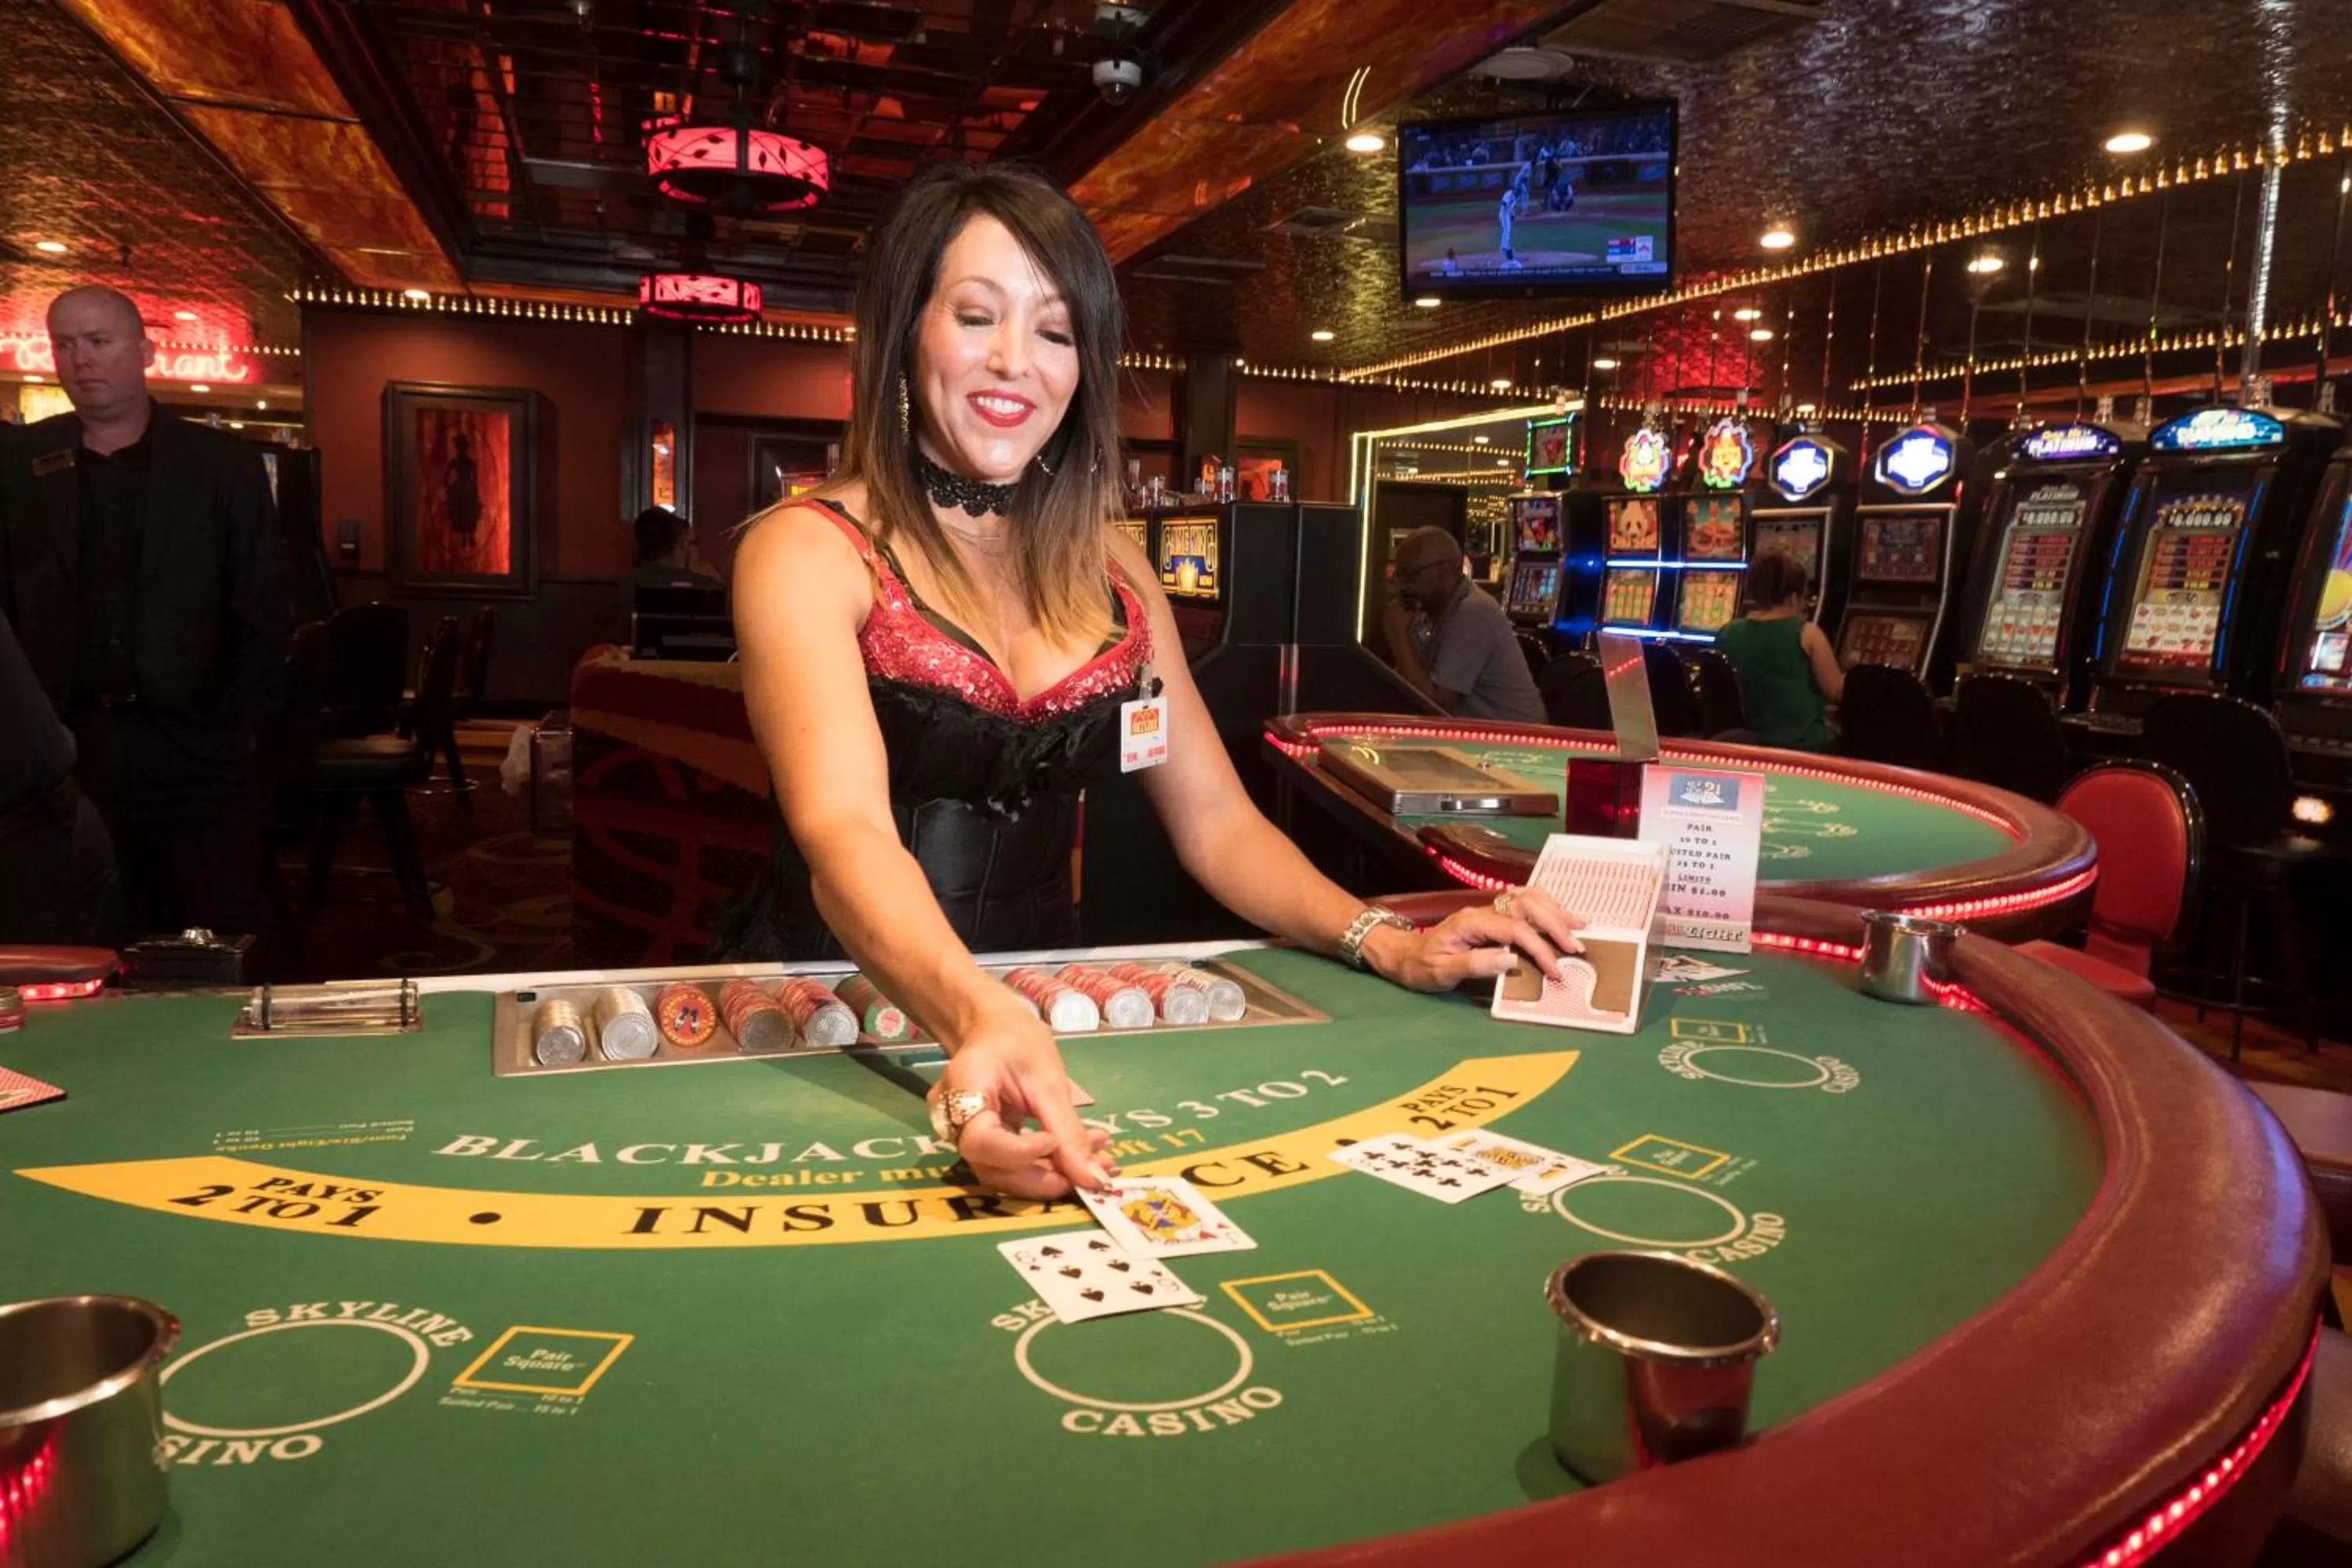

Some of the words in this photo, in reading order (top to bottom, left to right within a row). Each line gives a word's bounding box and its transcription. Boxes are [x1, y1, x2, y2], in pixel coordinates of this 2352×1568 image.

[1687, 823, 1711, 832] PAIR
[1670, 848, 1702, 857] UITED
[1706, 851, 1730, 860] PAIR
[1671, 884, 1686, 892] IN
[1679, 873, 1711, 884] LIMITS
[1081, 1109, 1174, 1134] YS
[1177, 1100, 1220, 1120] 3
[1214, 1080, 1308, 1107] TO
[1300, 1069, 1349, 1087] 2
[1399, 1083, 1468, 1113] PAYS
[1409, 1115, 1456, 1131] 2
[1441, 1096, 1496, 1117] TO
[1476, 1086, 1519, 1099] 1
[430, 1134, 960, 1165] BLACKJACK
[1160, 1127, 1207, 1149] 17
[249, 1177, 385, 1203] PAYS
[702, 1168, 864, 1188] Dealer
[879, 1165, 952, 1181] mu
[167, 1185, 234, 1207] 2
[229, 1195, 321, 1219] TO
[326, 1206, 381, 1226] 1
[621, 1149, 1311, 1235] INSURCE
[1686, 1212, 1786, 1264] CASINO
[245, 1301, 474, 1348] SKYLINE
[503, 1355, 574, 1372] Square
[530, 1348, 573, 1363] Pair
[1062, 1386, 1283, 1437] CASINO
[157, 1434, 323, 1466] SINO
